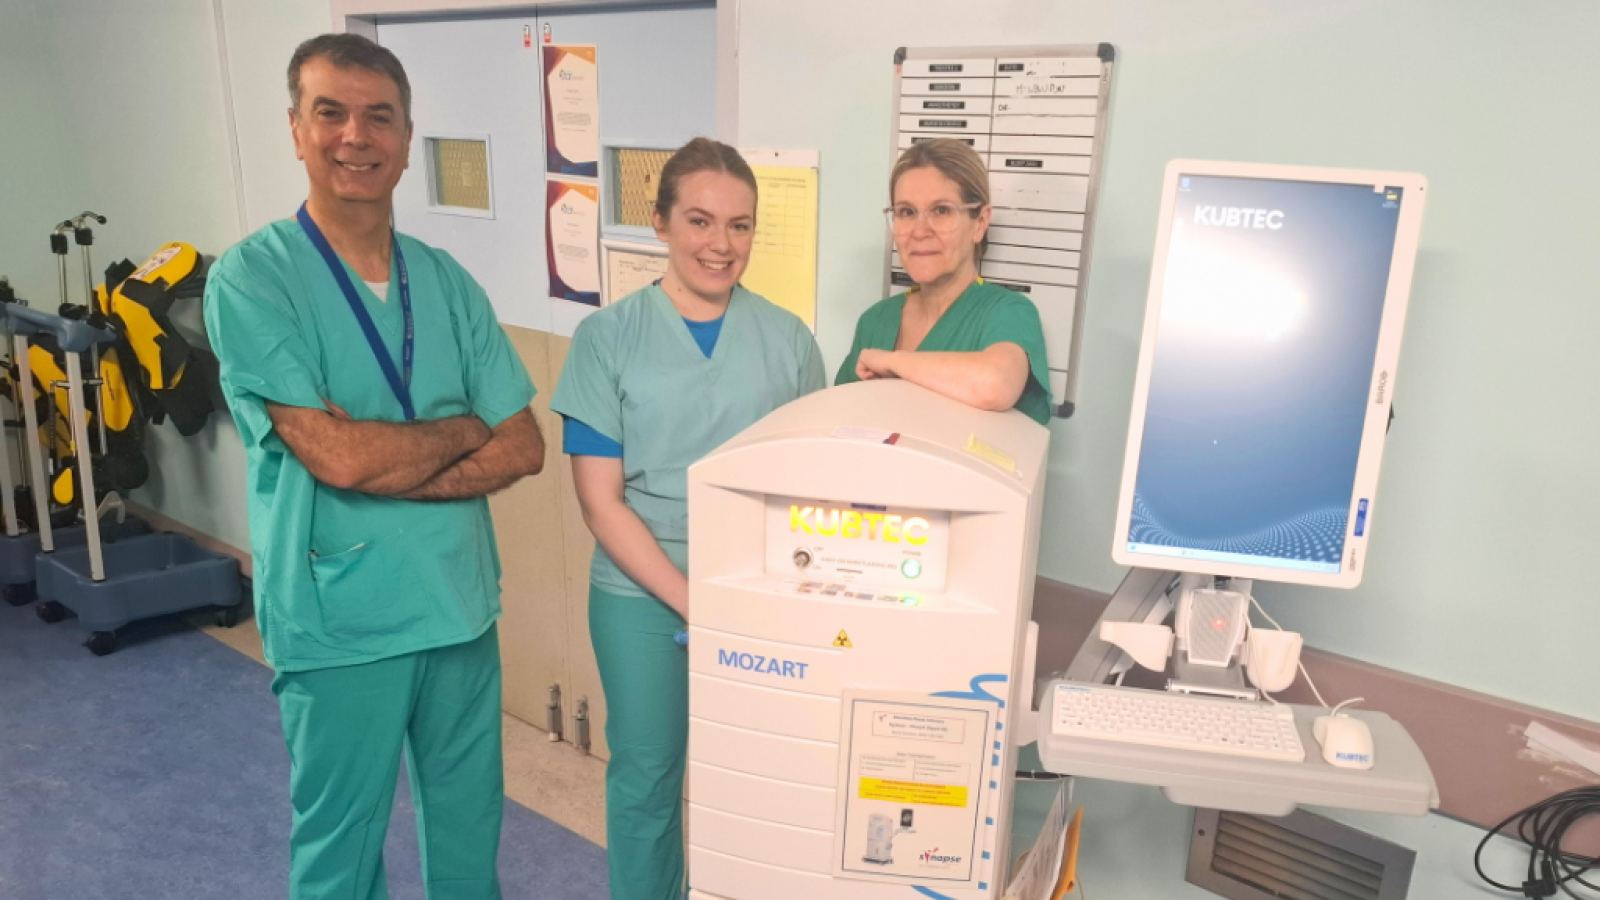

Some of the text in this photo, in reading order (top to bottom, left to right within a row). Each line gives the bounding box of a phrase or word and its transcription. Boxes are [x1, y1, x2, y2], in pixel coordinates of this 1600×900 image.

[1193, 204, 1285, 231] KUBTEC
[790, 505, 930, 545] KUBTEC
[718, 648, 809, 680] MOZART
[918, 850, 962, 864] synapse
